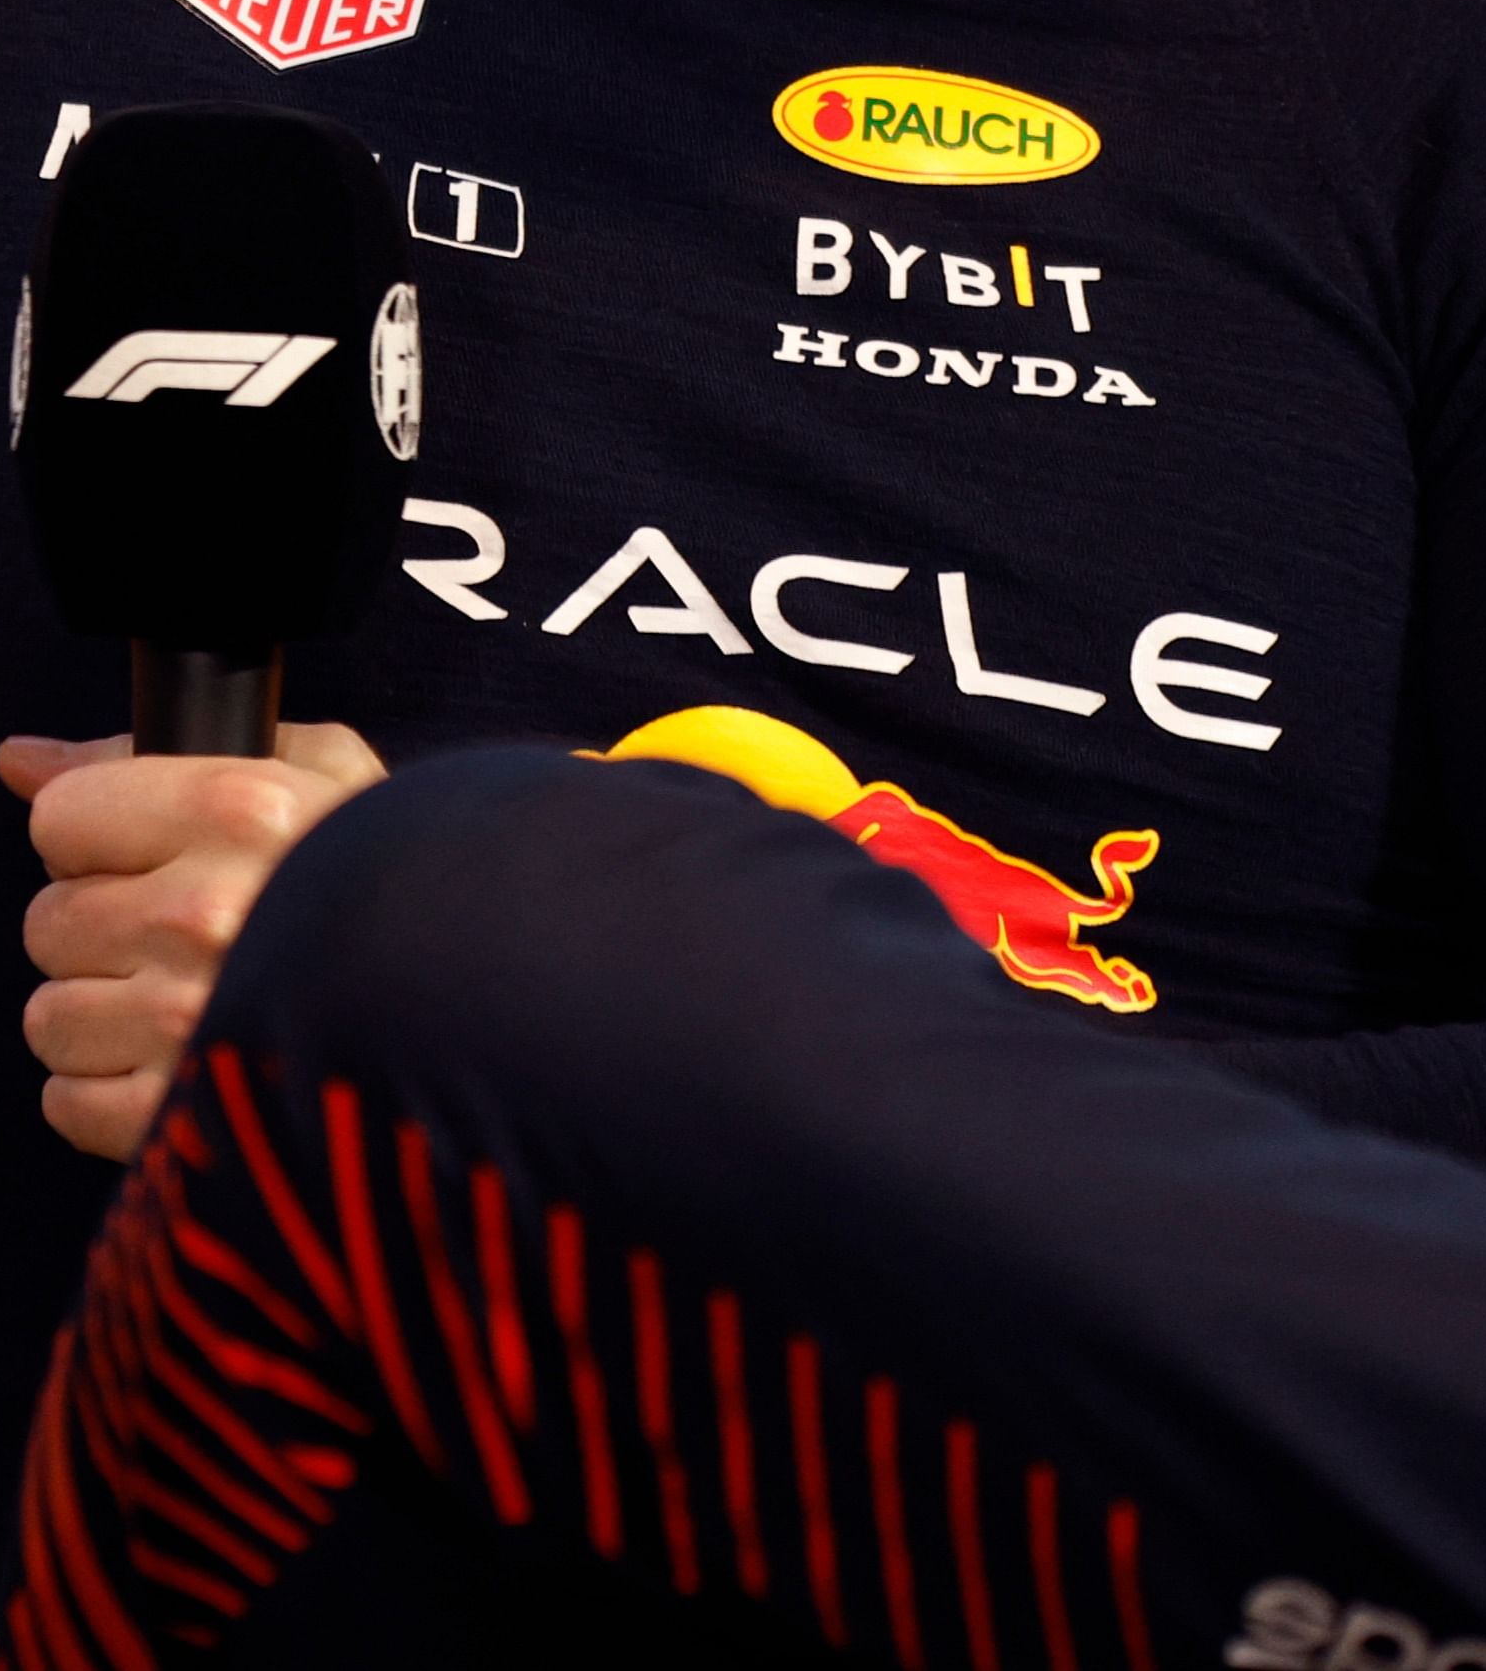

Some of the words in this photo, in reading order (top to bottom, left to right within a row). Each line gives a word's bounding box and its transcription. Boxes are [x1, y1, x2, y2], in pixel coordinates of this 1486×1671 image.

[861, 96, 1055, 161] RAUCH
[448, 179, 480, 243] 1
[796, 217, 1102, 333] BYBIT
[772, 323, 1157, 407] HONDA
[402, 497, 1283, 753] RACLE
